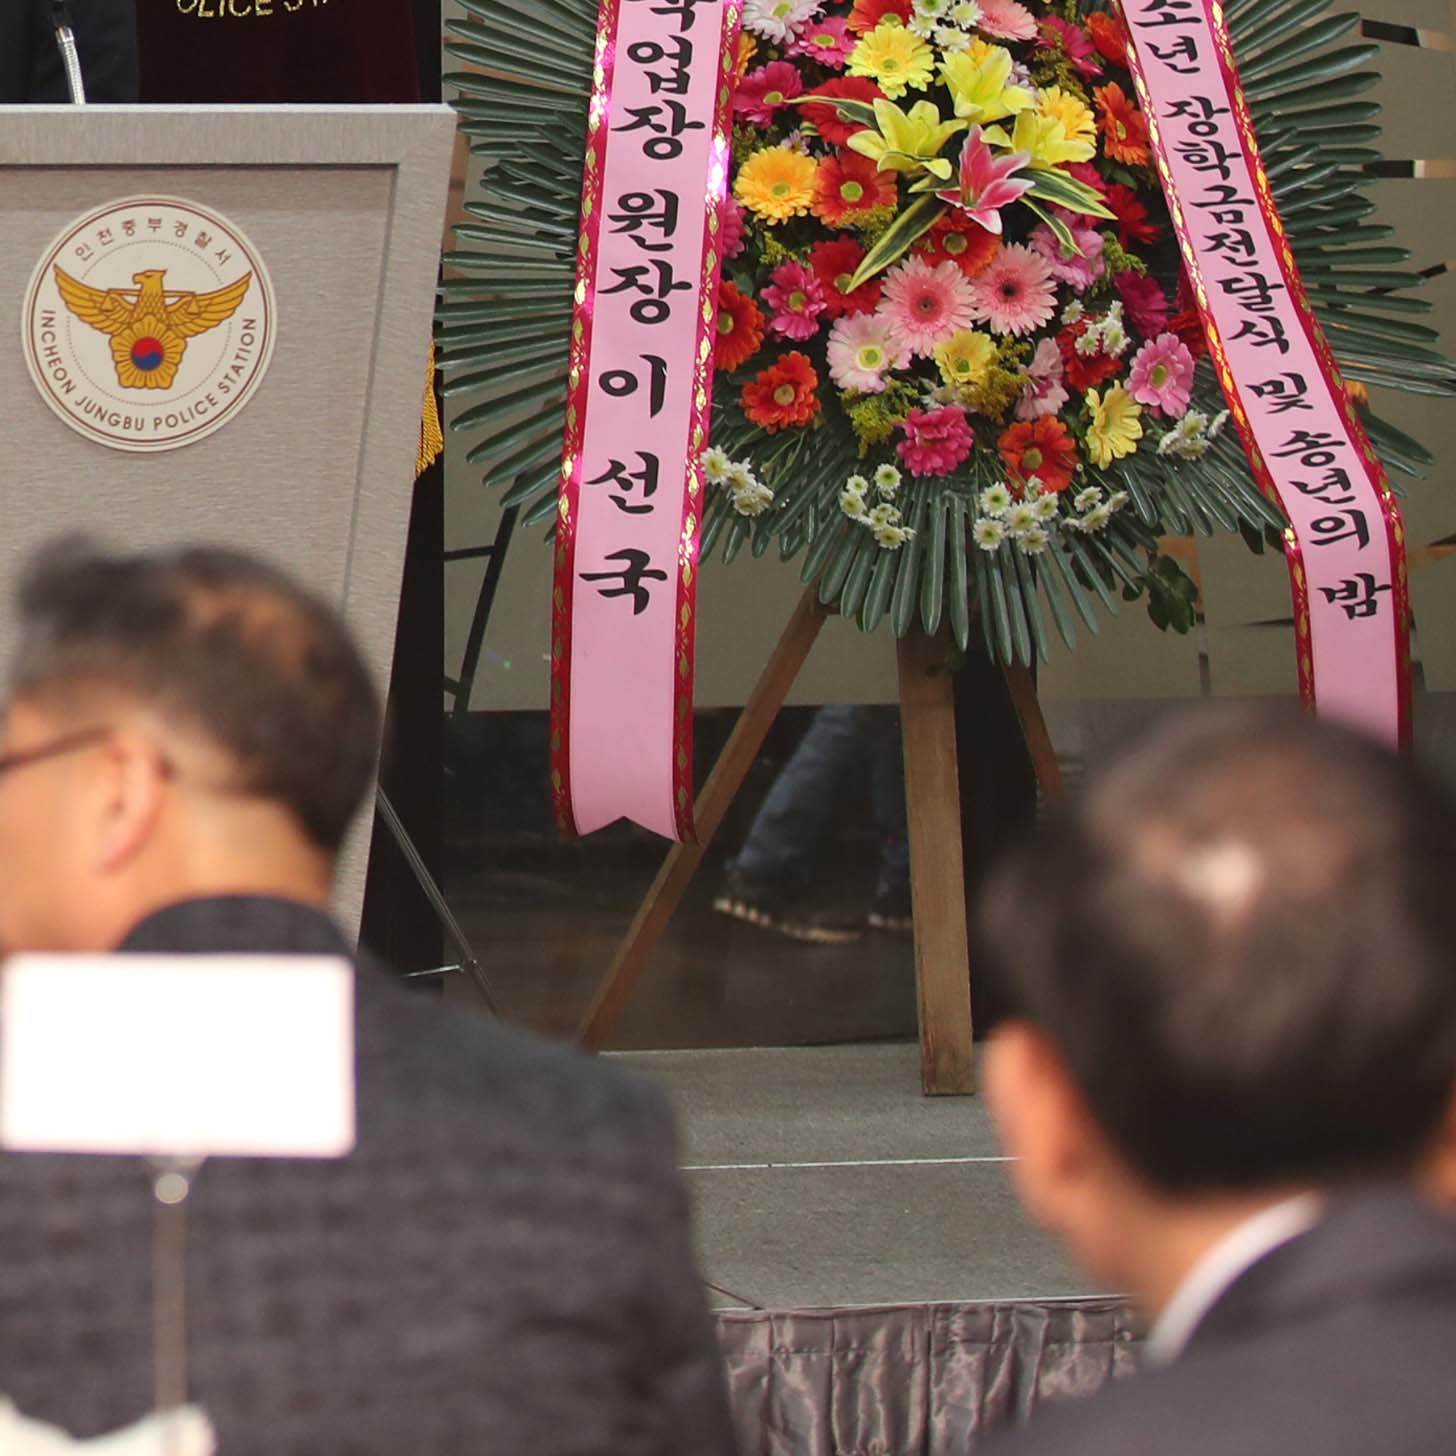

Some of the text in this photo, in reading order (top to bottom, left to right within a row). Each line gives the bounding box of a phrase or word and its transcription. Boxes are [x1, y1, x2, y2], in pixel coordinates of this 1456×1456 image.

[75, 217, 232, 266] 인천중부경찰서
[599, 189, 693, 326] 원장
[40, 309, 257, 431] INCHEON JUNGBU POLICE STATION
[1246, 373, 1313, 413] 및
[579, 353, 669, 616] 이선국
[1268, 429, 1370, 549] 송년의
[1317, 573, 1393, 620] 밤
